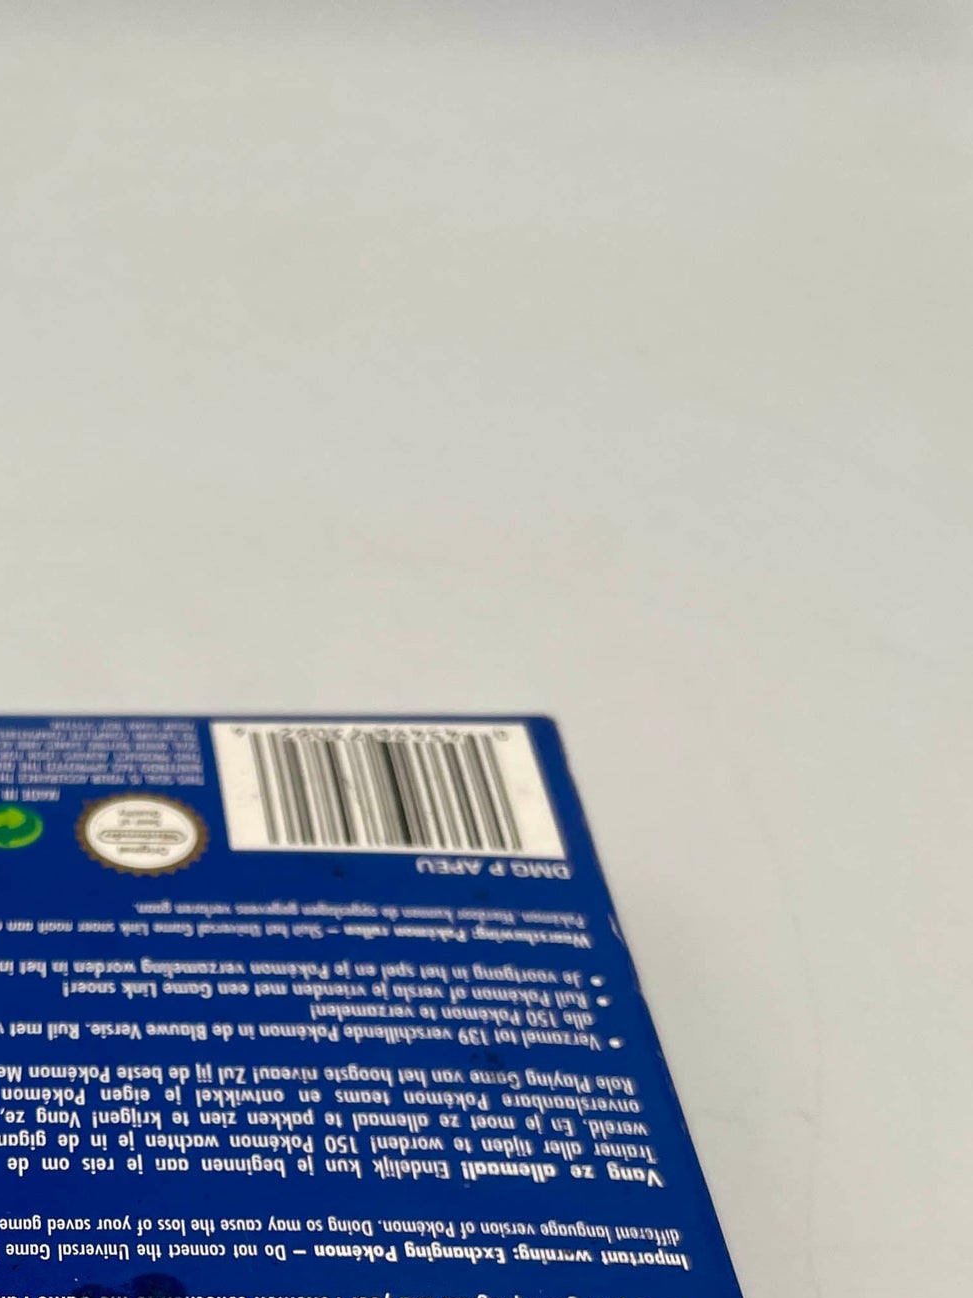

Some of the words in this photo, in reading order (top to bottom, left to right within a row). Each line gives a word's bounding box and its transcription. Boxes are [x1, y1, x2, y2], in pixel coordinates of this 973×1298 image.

[414, 856, 482, 874] APEU
[487, 859, 503, 876] P
[510, 860, 570, 878] DMG
[0, 1087, 85, 1107] Pokémon
[99, 1083, 150, 1105] eigen
[164, 1084, 181, 1105] je
[194, 1088, 284, 1108] ontwikkel
[297, 1089, 321, 1102] en
[334, 1089, 390, 1106] teams
[402, 1090, 488, 1111] Pokémon
[501, 1093, 640, 1116] onverslaanbare
[46, 1217, 91, 1236] saved
[95, 1214, 131, 1230] your
[136, 1217, 152, 1236] of
[156, 1218, 186, 1236] loss
[189, 1218, 215, 1236] the
[219, 1218, 262, 1231] cause
[267, 1215, 301, 1231] may
[305, 1218, 323, 1232] so
[326, 1215, 373, 1236] Doing
[377, 1219, 455, 1238] Pokémon.
[459, 1220, 475, 1239] of
[479, 1221, 535, 1238] version
[539, 1219, 612, 1243] language
[614, 1225, 680, 1246] different
